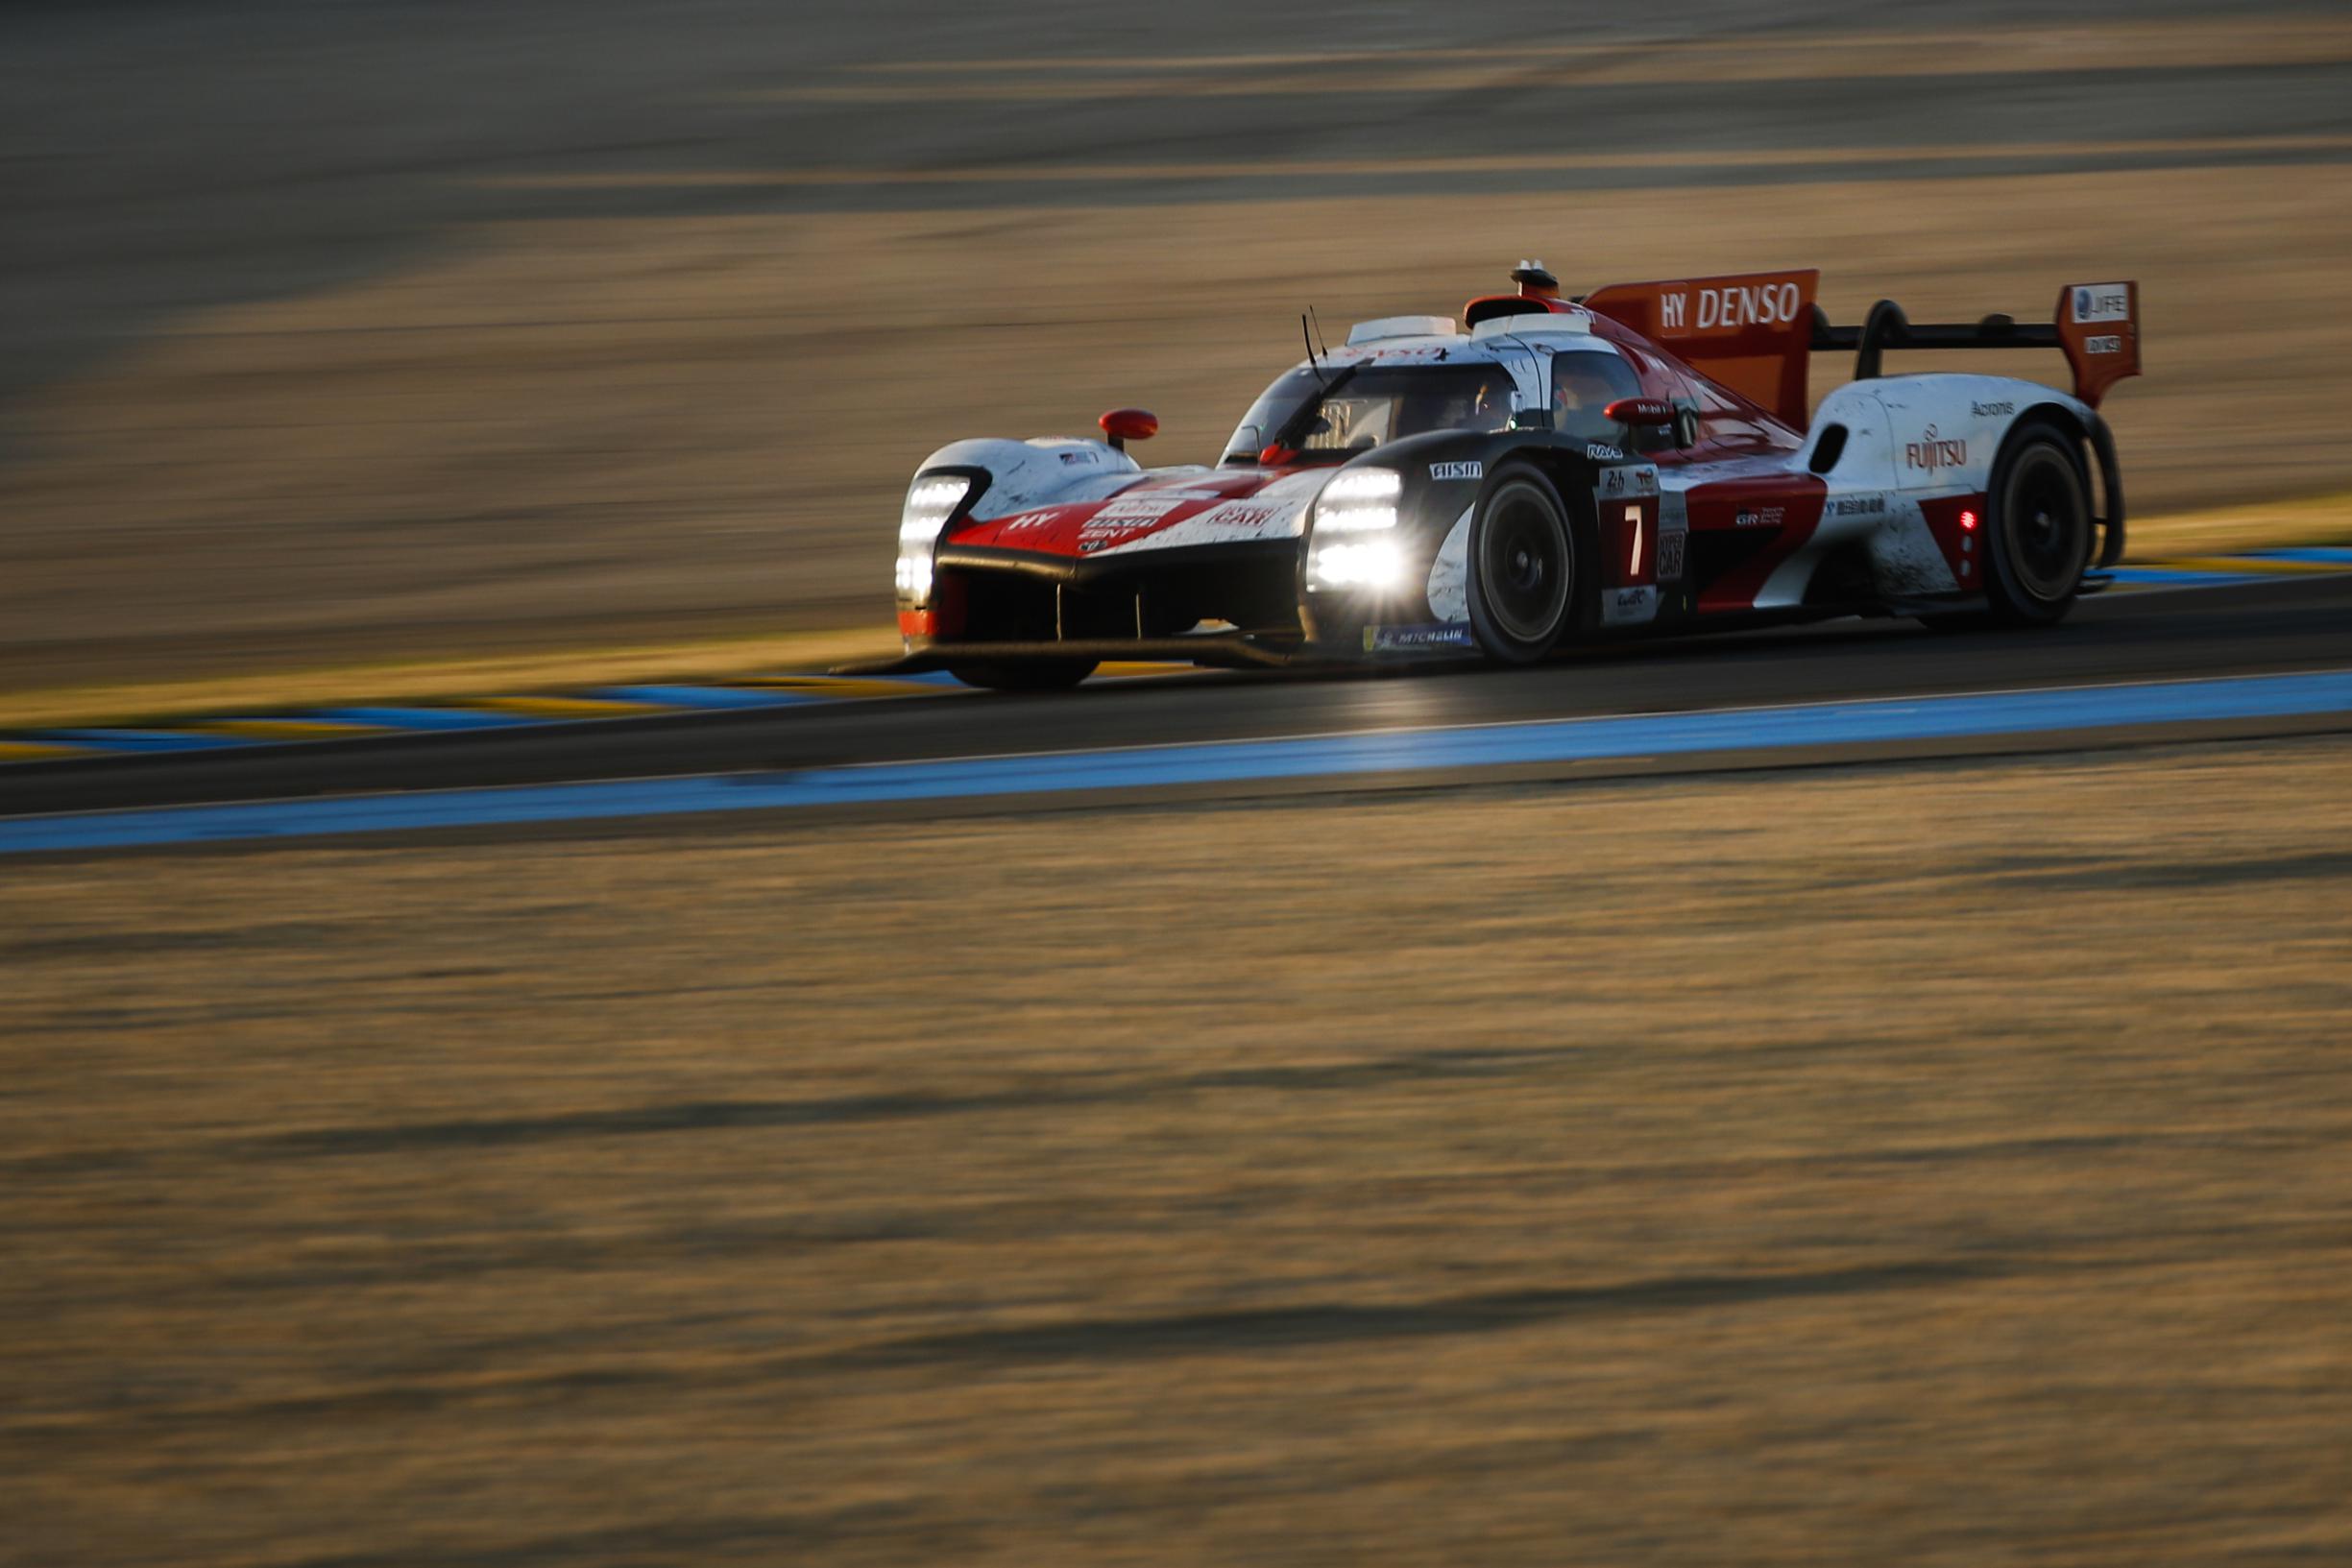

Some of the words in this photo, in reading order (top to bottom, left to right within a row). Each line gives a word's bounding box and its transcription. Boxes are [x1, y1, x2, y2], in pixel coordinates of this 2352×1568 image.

[1661, 293, 1687, 328] HY
[1696, 282, 1801, 328] DENSO
[1587, 445, 1623, 459] RAYS
[1905, 439, 1967, 475] FUJITSU
[1432, 463, 1481, 478] AISIN
[1008, 512, 1060, 530] HY
[1077, 528, 1136, 539] ZENT
[1625, 505, 1643, 576] 7
[1659, 551, 1682, 574] CAR
[1398, 629, 1463, 644] MICHELIN
